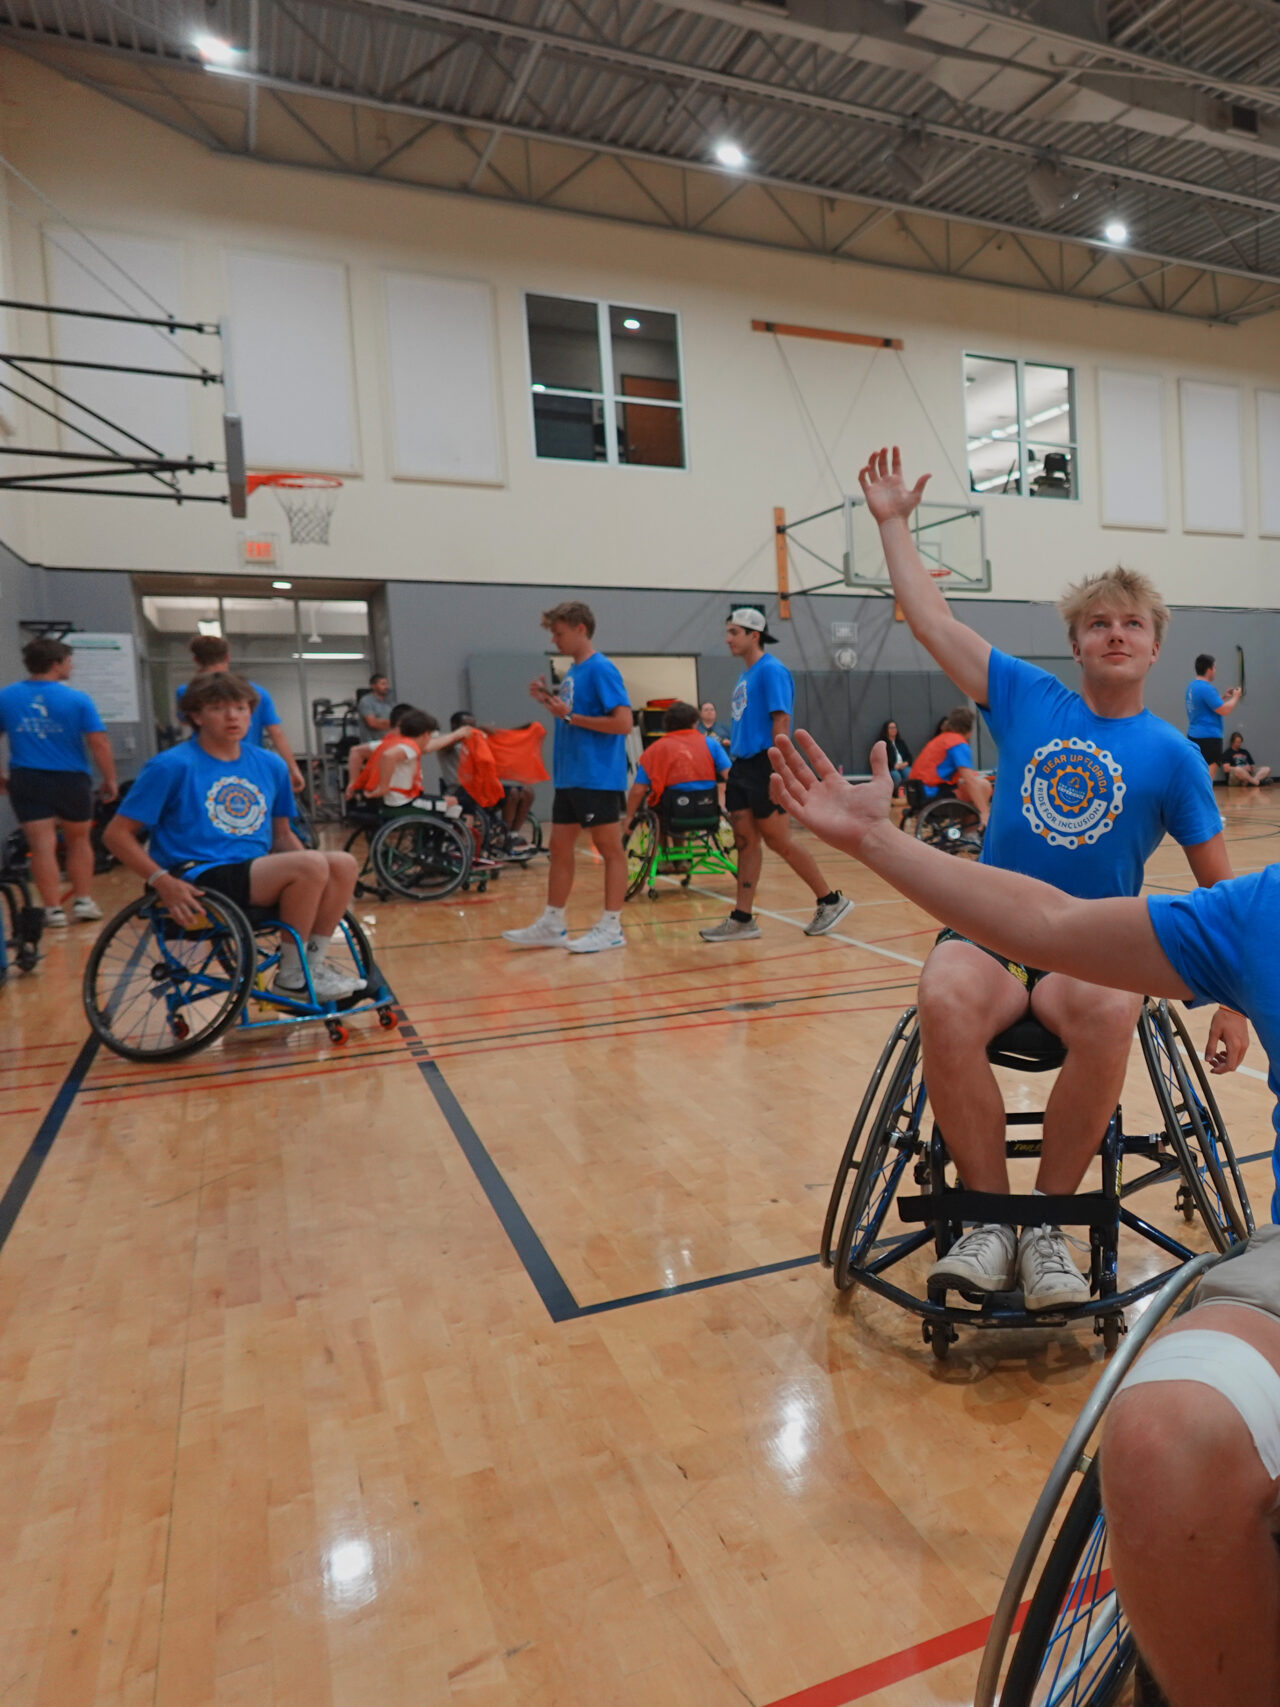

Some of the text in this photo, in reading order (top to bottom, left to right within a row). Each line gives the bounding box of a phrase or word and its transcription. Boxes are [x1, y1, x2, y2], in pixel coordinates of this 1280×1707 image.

[1070, 754, 1083, 762] UP
[1037, 787, 1046, 808] RIDE
[1043, 807, 1057, 823] FOR
[1058, 807, 1100, 829] INCLUSION
